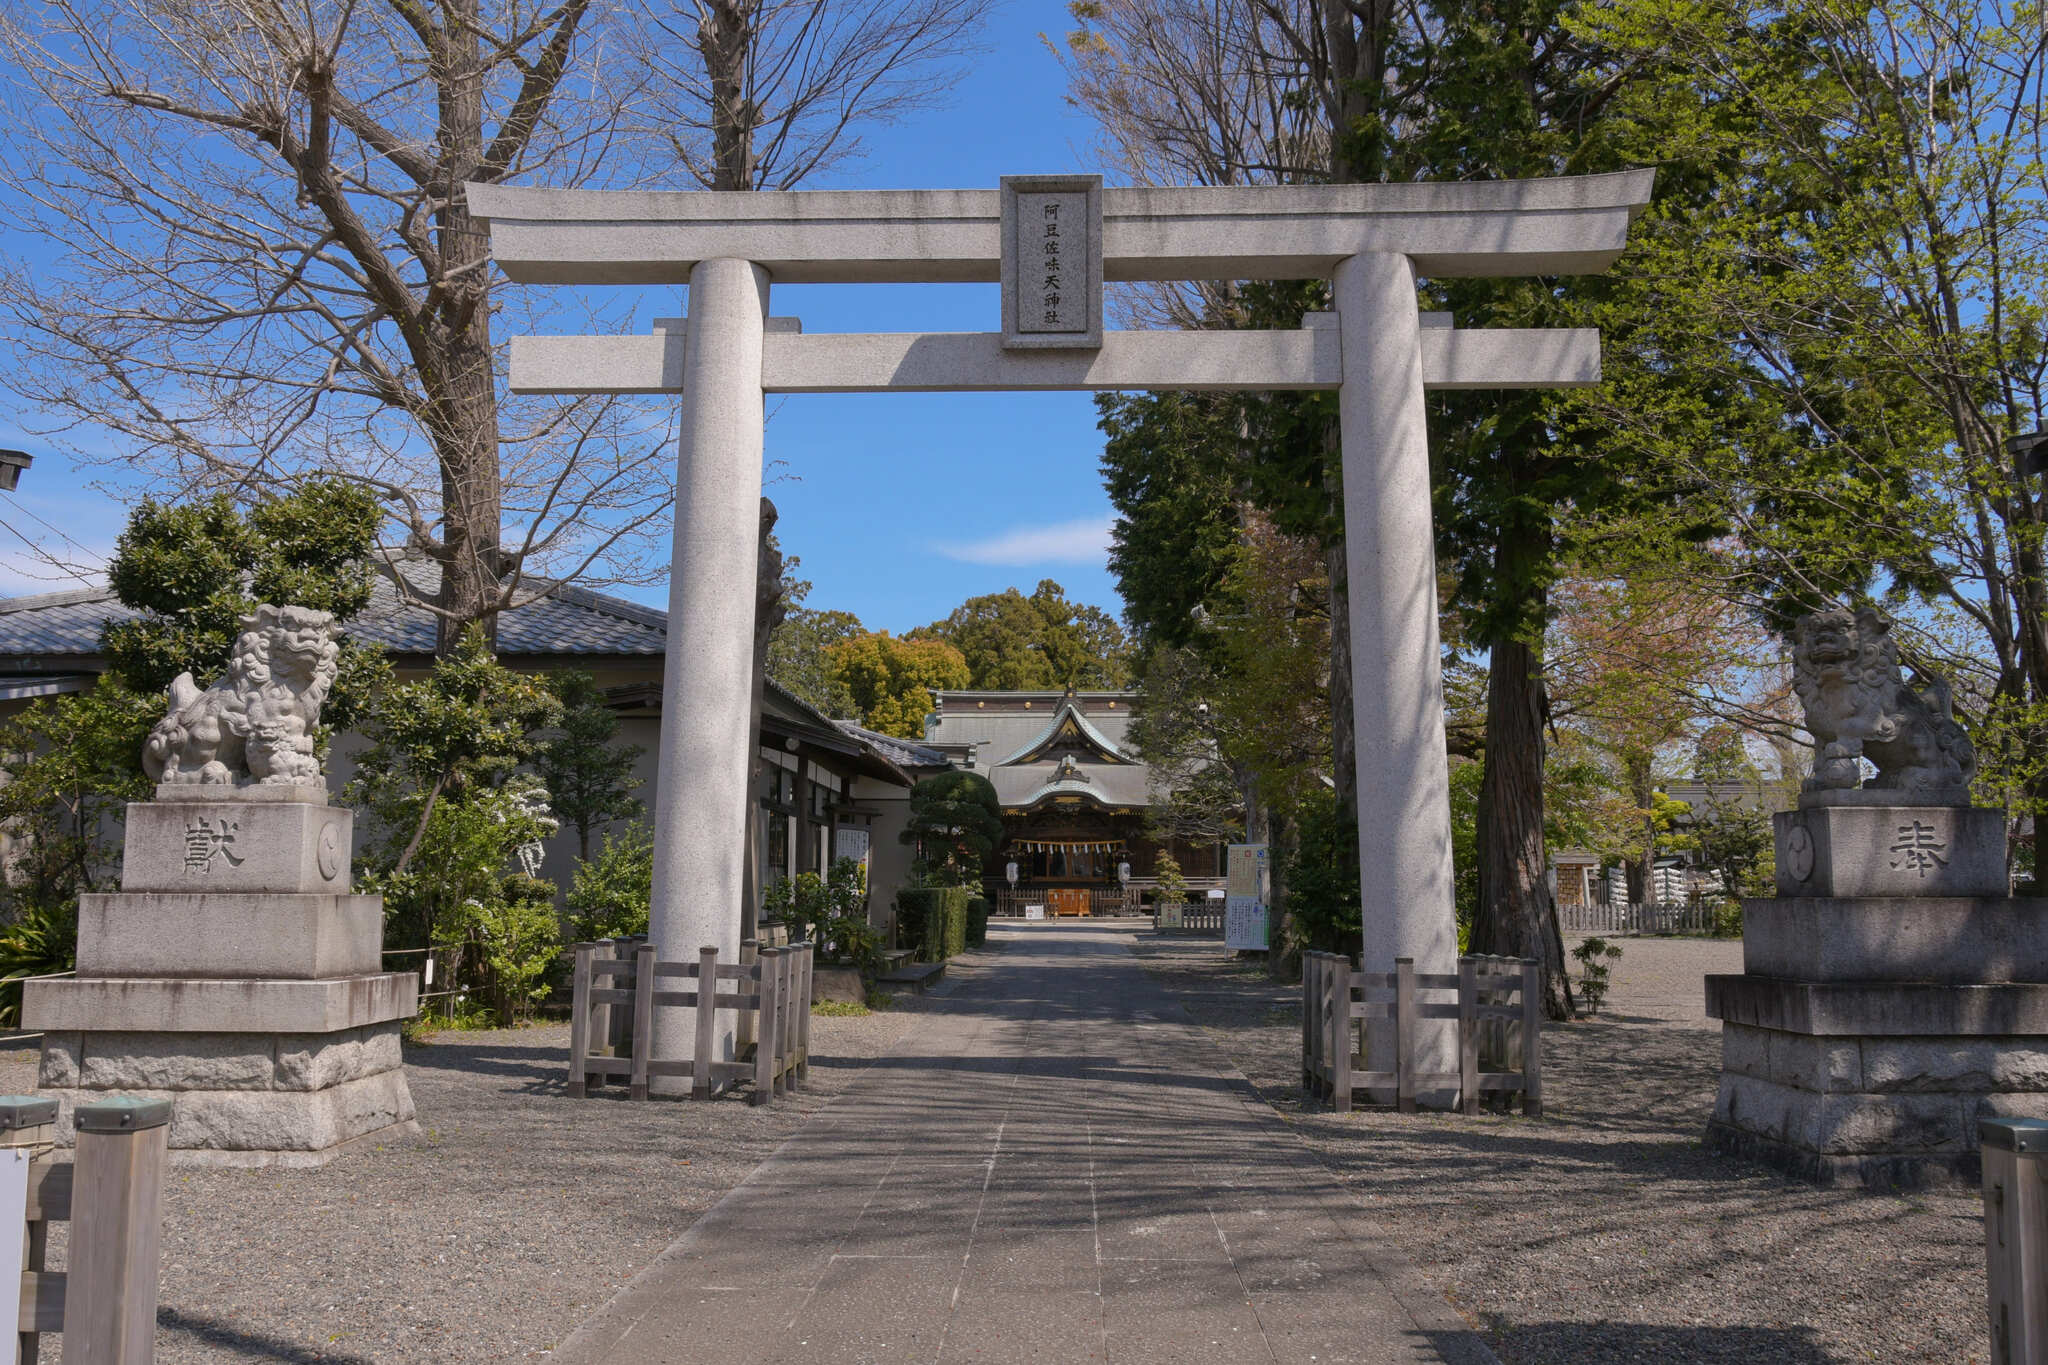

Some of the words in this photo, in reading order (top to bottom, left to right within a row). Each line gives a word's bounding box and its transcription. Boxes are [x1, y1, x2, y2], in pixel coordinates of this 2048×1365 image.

[1043, 204, 1061, 324] 阿豆佐味天神社
[1889, 820, 1950, 878] 奉
